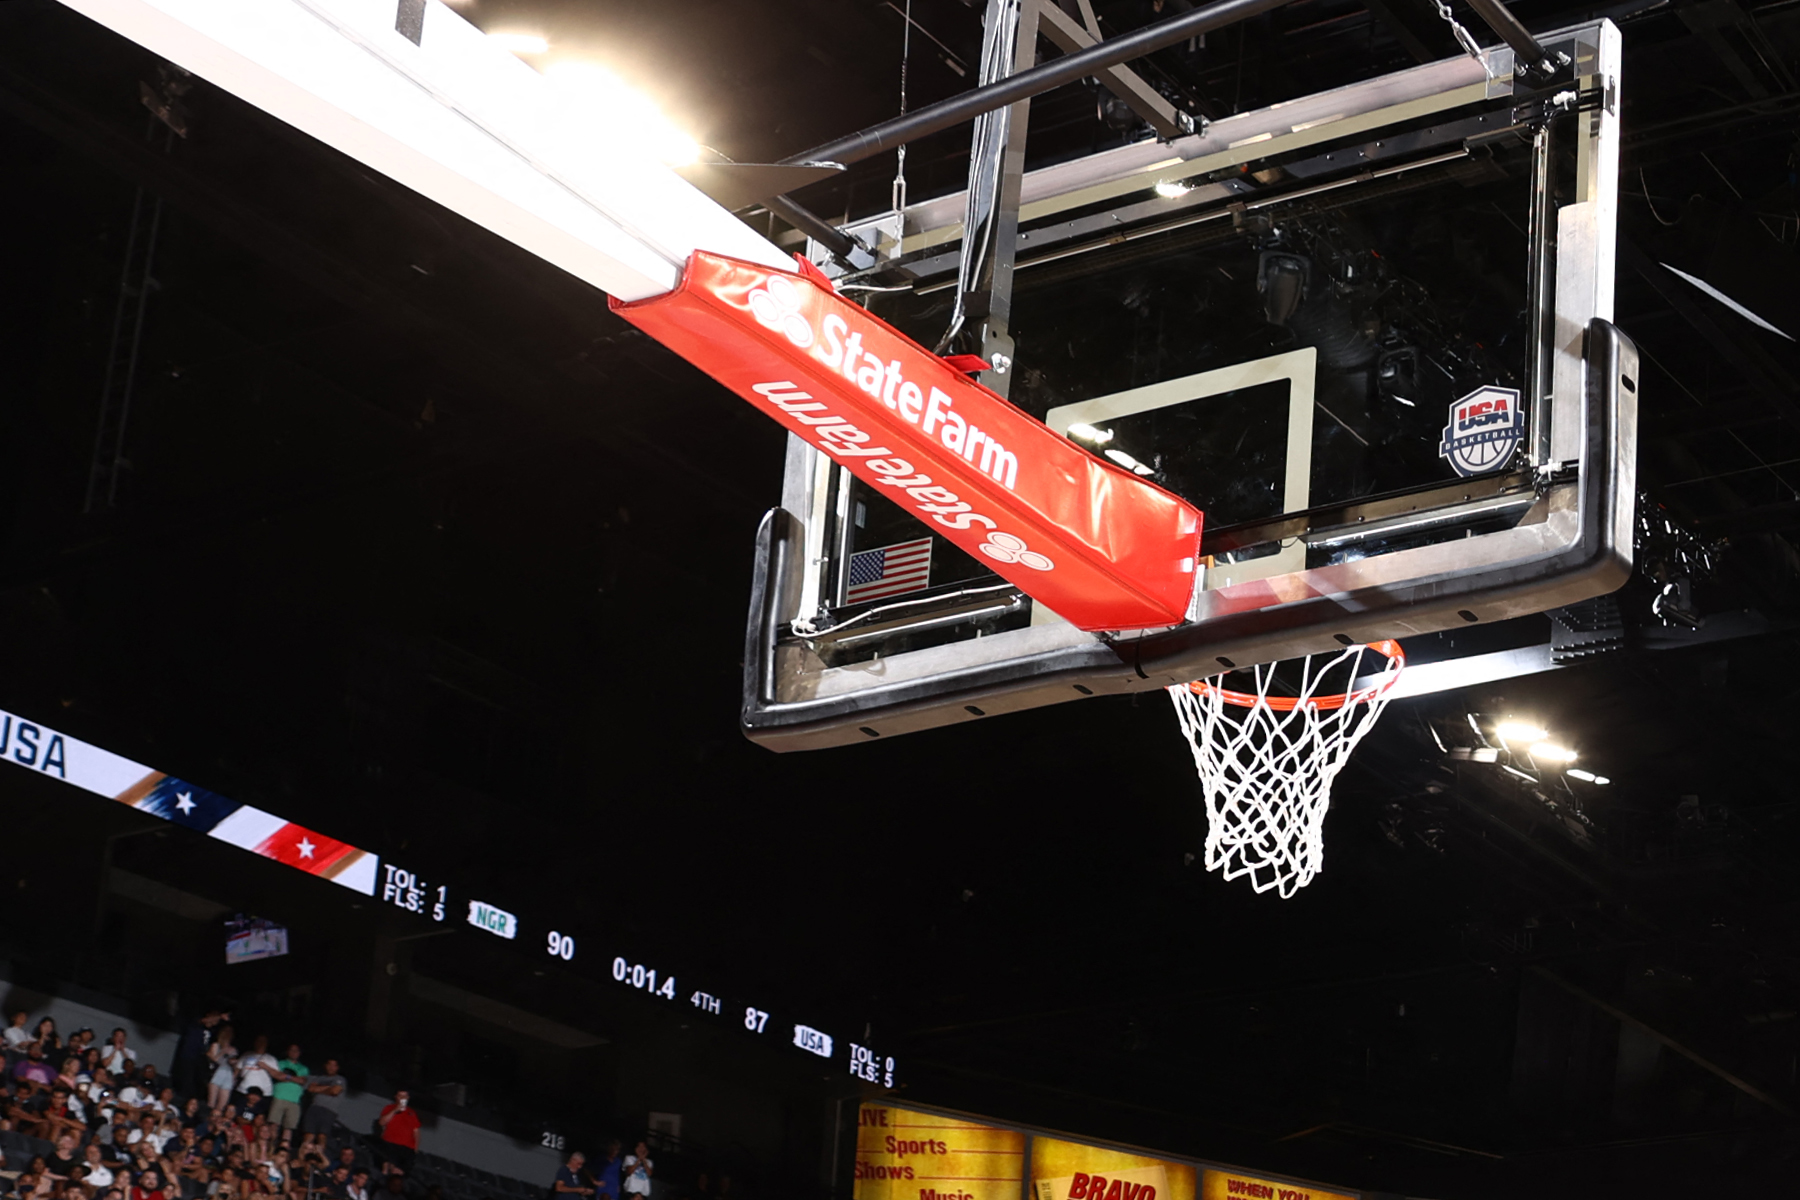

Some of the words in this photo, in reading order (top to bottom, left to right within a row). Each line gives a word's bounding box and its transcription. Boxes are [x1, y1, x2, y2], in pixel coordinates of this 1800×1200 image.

[1459, 399, 1510, 432] USA
[1445, 429, 1520, 450] BASKETBALL
[384, 863, 427, 896] TOL:
[437, 885, 446, 903] 1
[383, 883, 425, 914] FLS:
[432, 903, 445, 921] 5
[476, 905, 508, 934] NGR
[547, 931, 574, 960] 90
[612, 957, 675, 1000] 0:01.4
[690, 991, 721, 1015] 4TH
[744, 1007, 769, 1033] 87
[800, 1028, 824, 1054] USA
[849, 1043, 880, 1068] TOL:
[885, 1056, 894, 1072] 0
[849, 1060, 879, 1083] FLS:
[884, 1072, 893, 1088] 5
[885, 1136, 947, 1158] Sports
[1227, 1179, 1273, 1200] WHEN
